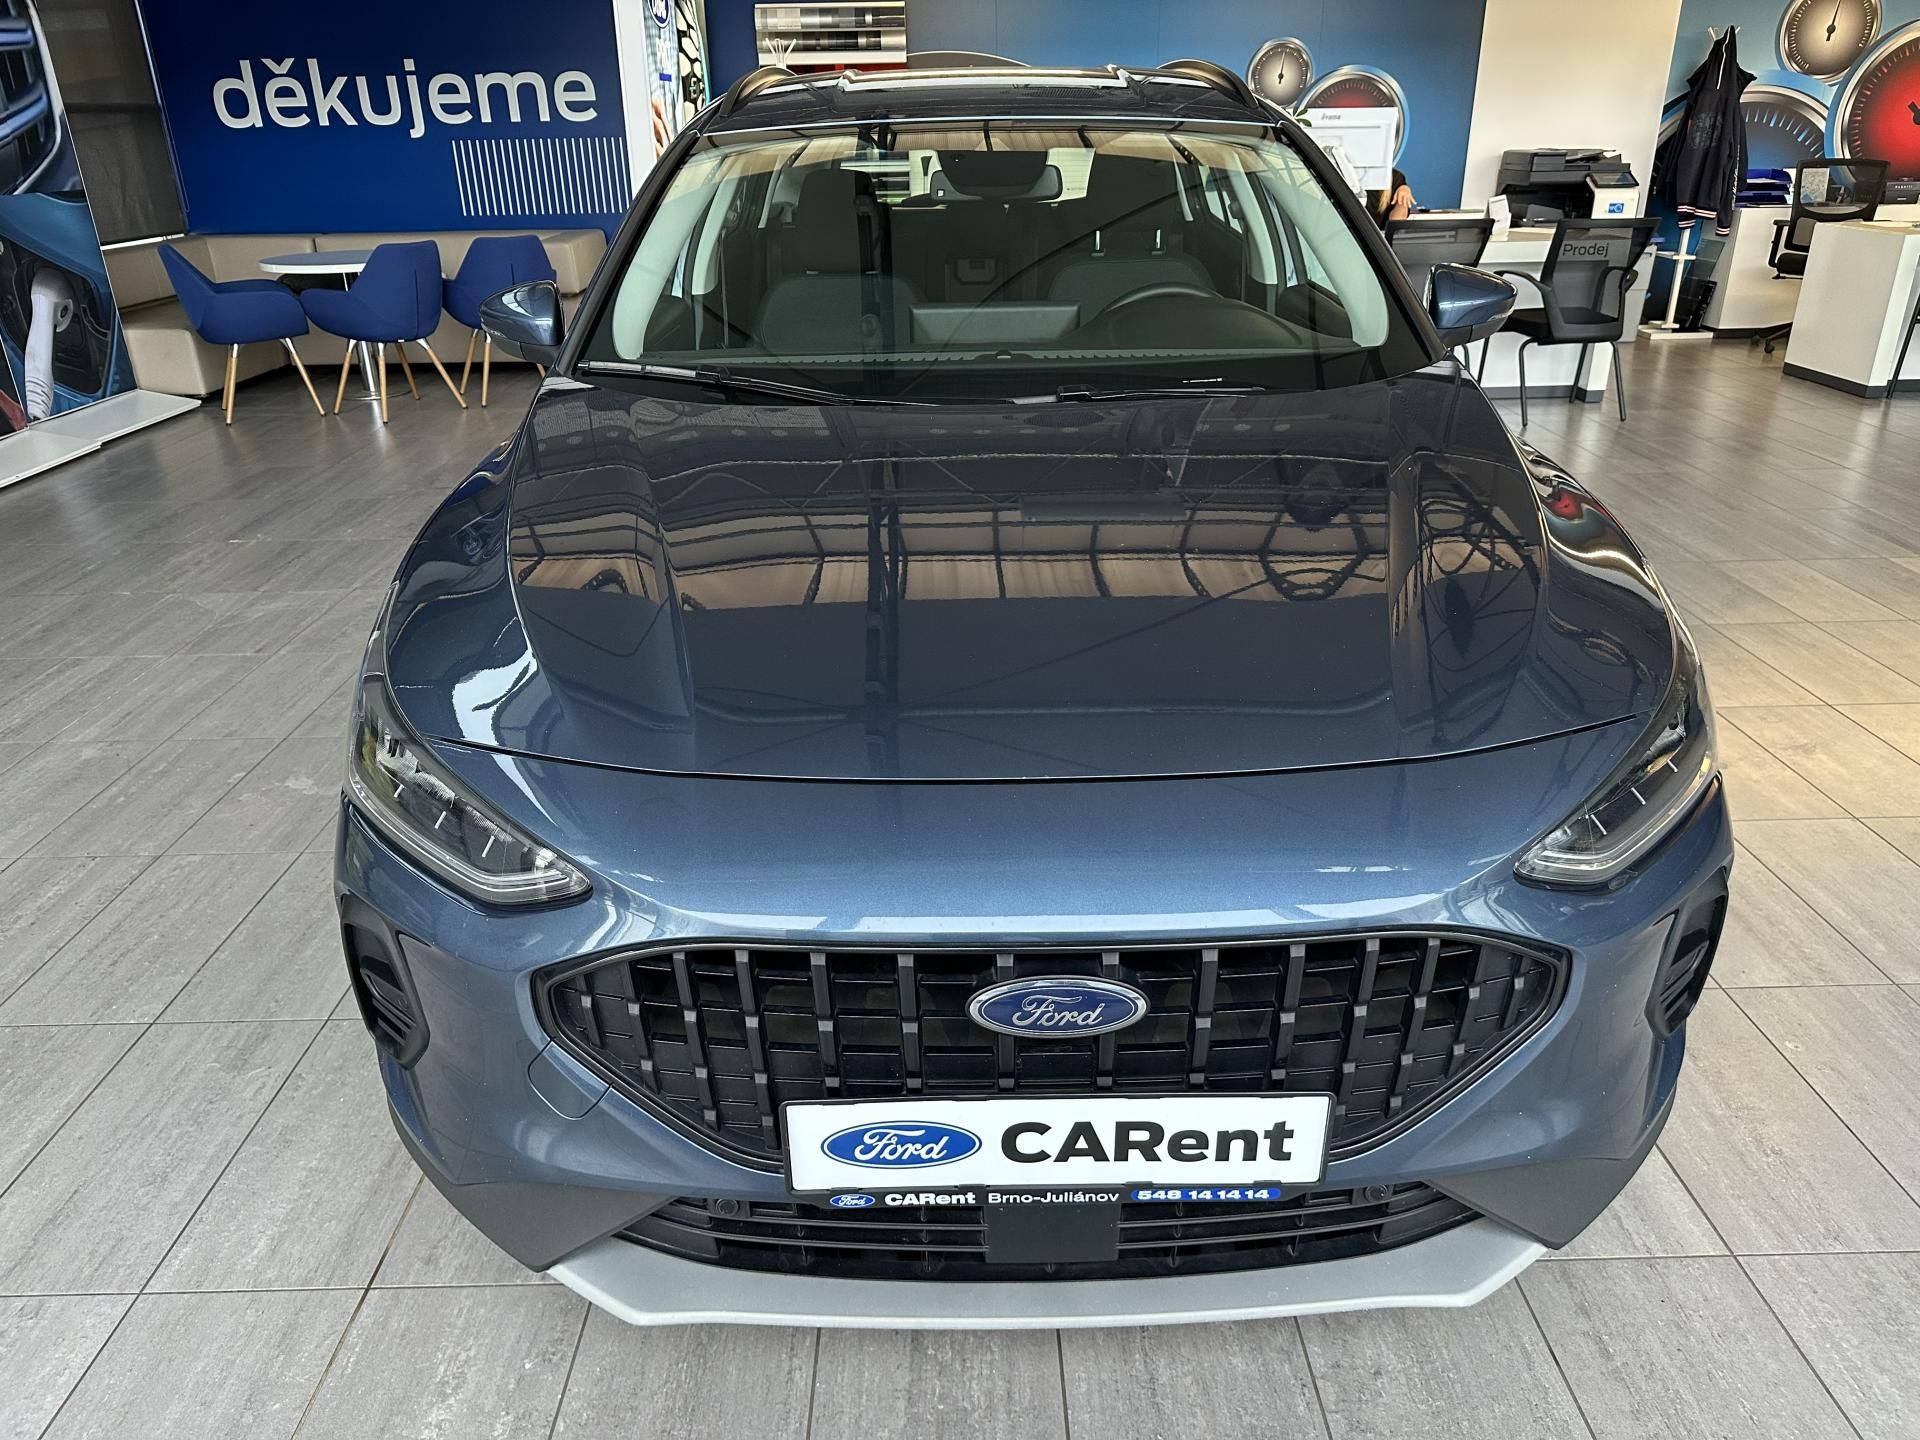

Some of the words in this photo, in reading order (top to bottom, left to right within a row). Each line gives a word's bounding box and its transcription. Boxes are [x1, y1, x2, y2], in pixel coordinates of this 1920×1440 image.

[213, 57, 598, 139] děkujeme
[1562, 242, 1609, 258] Prodej
[1012, 994, 1105, 1027] Ford
[854, 1128, 949, 1161] Ford
[1000, 1120, 1295, 1163] CARent
[838, 1194, 866, 1206] Ford
[884, 1191, 977, 1206] CARent
[988, 1191, 1120, 1204] Brno-Juliánov
[1137, 1189, 1182, 1200] 548
